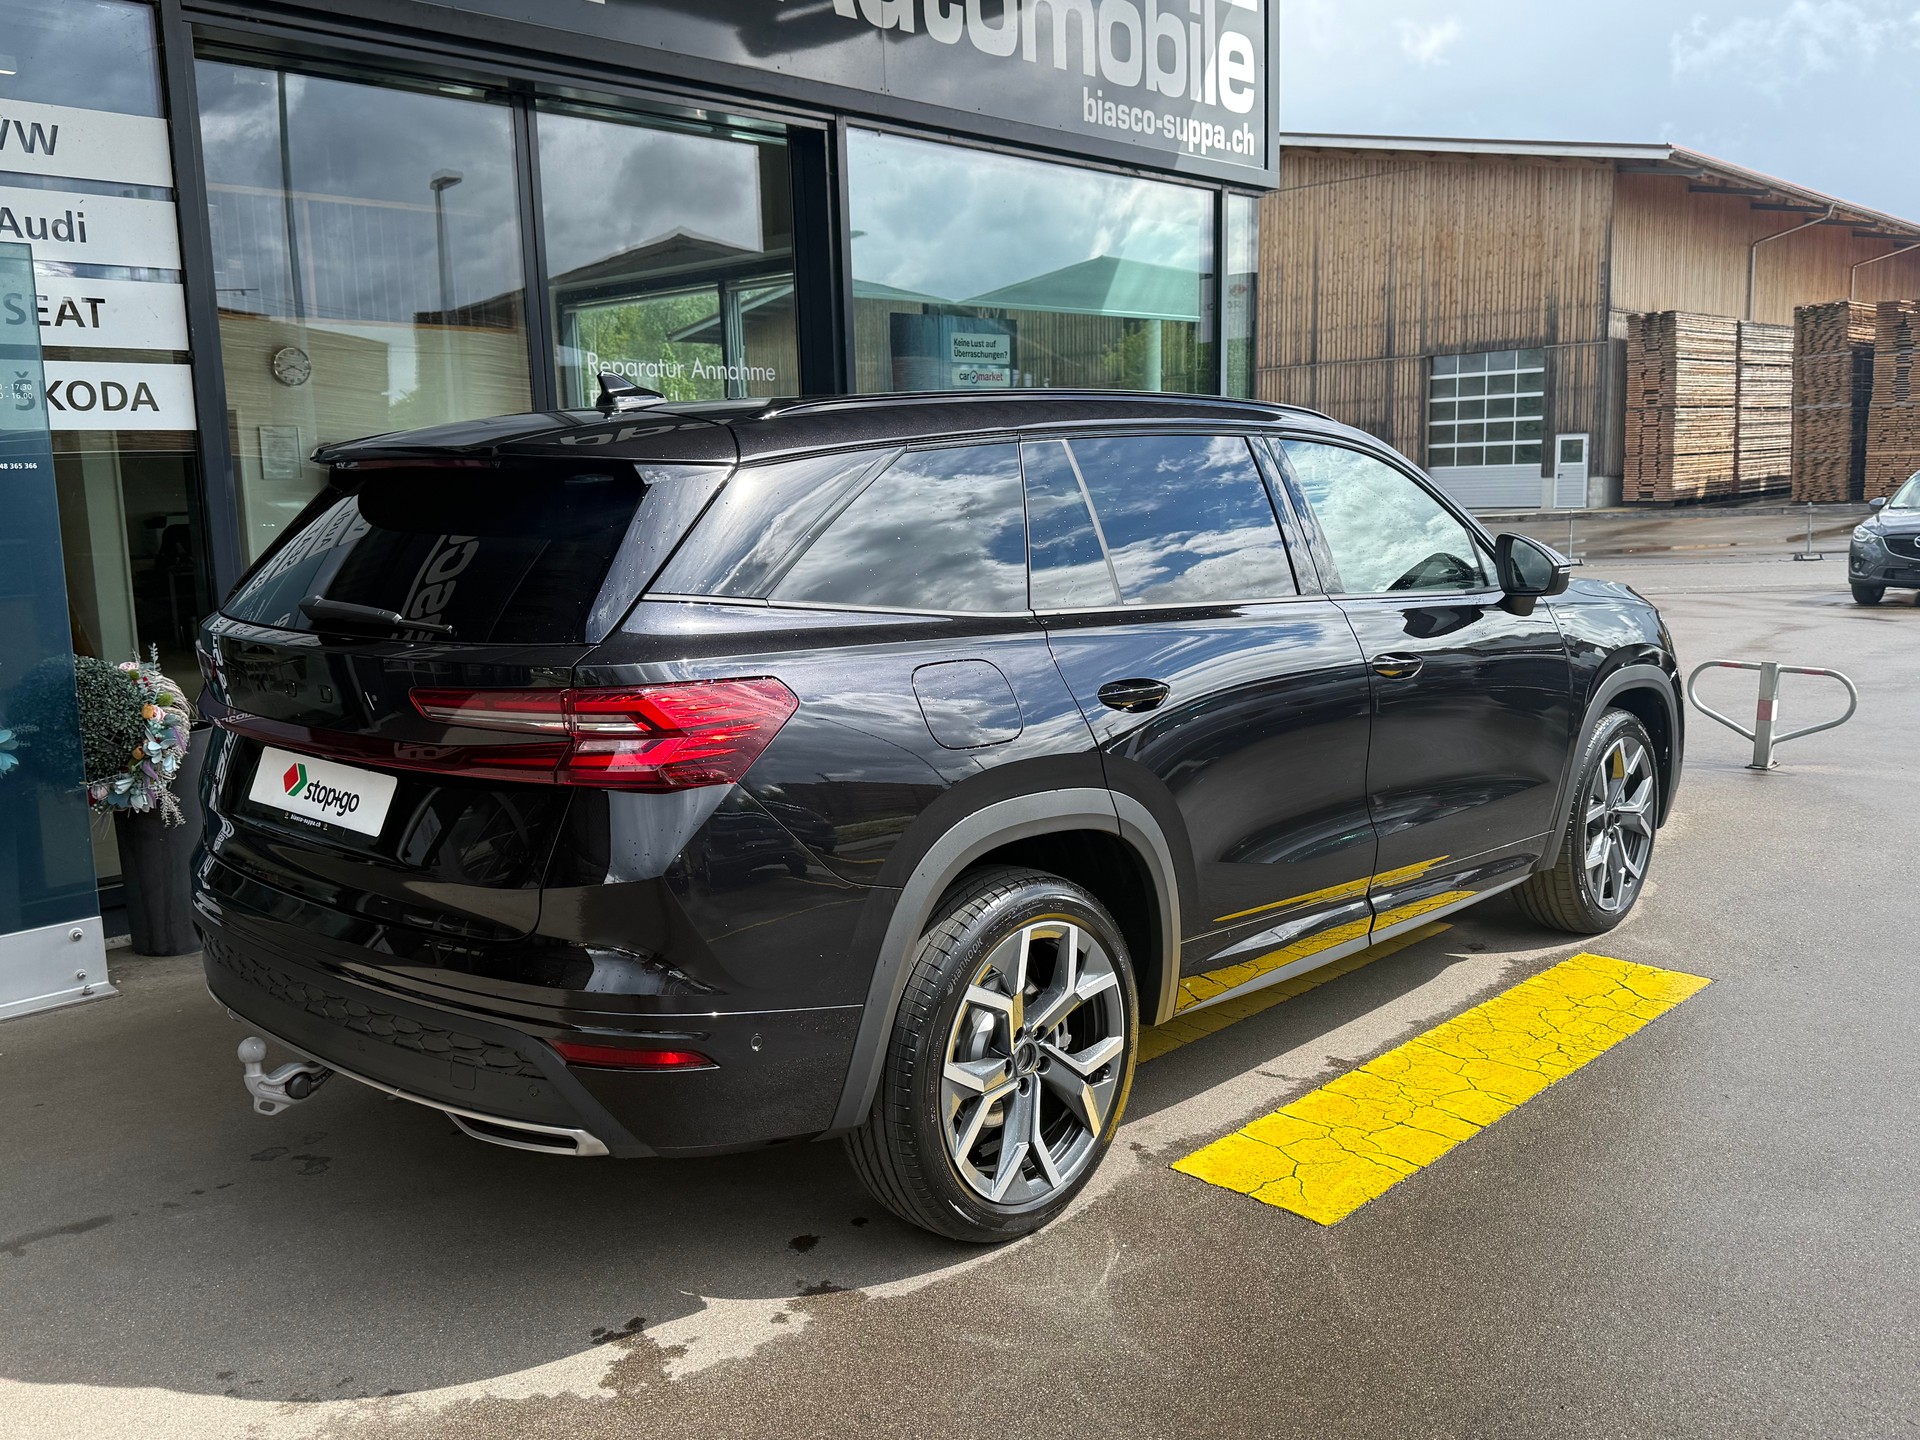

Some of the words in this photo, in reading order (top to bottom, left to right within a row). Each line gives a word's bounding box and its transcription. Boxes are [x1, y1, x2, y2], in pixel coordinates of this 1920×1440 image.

[832, 0, 1255, 114] omobile
[1083, 86, 1255, 156] biasco-suppa.ch
[0, 206, 87, 243] Audi
[3, 292, 106, 328] SEAT
[953, 338, 970, 348] Keine
[971, 339, 984, 348] Lust
[985, 340, 997, 349] auf
[953, 347, 1008, 360] Überraschungen?
[587, 352, 685, 379] Reparatur
[691, 356, 776, 382] Annahme
[11, 383, 32, 391] 17.30
[12, 392, 33, 400] 16.00
[14, 370, 160, 412] ŠKODA
[9, 462, 23, 470] 365
[24, 462, 38, 470] 366
[304, 780, 360, 817] stop+go
